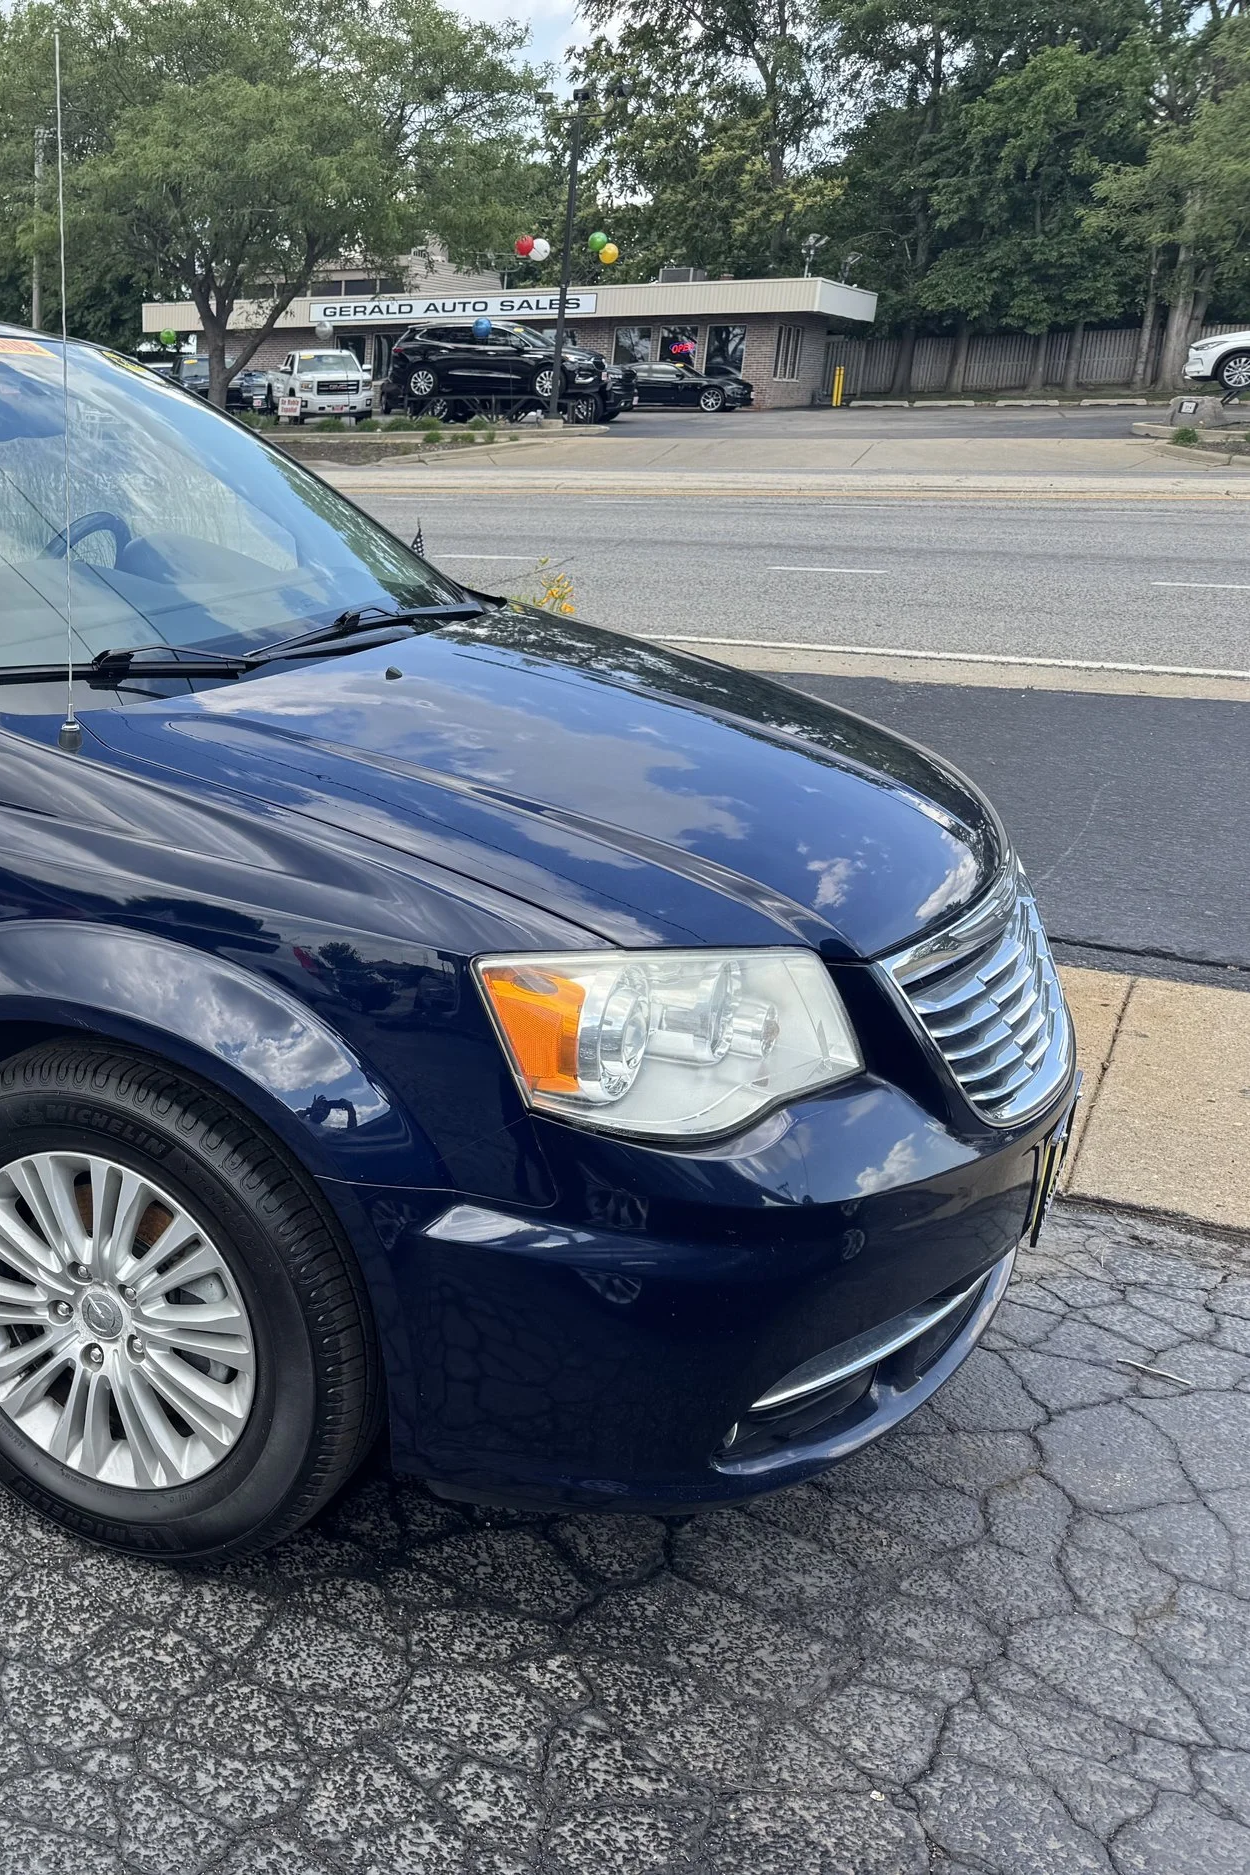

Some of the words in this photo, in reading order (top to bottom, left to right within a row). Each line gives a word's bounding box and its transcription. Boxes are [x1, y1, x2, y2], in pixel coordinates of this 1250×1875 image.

[323, 303, 414, 317] GERALD
[423, 301, 489, 314] AUTO
[499, 298, 581, 311] SALES
[671, 341, 695, 354] OPEN
[45, 1103, 167, 1158] MICHELIN
[12, 1476, 129, 1541] MICHELIN
